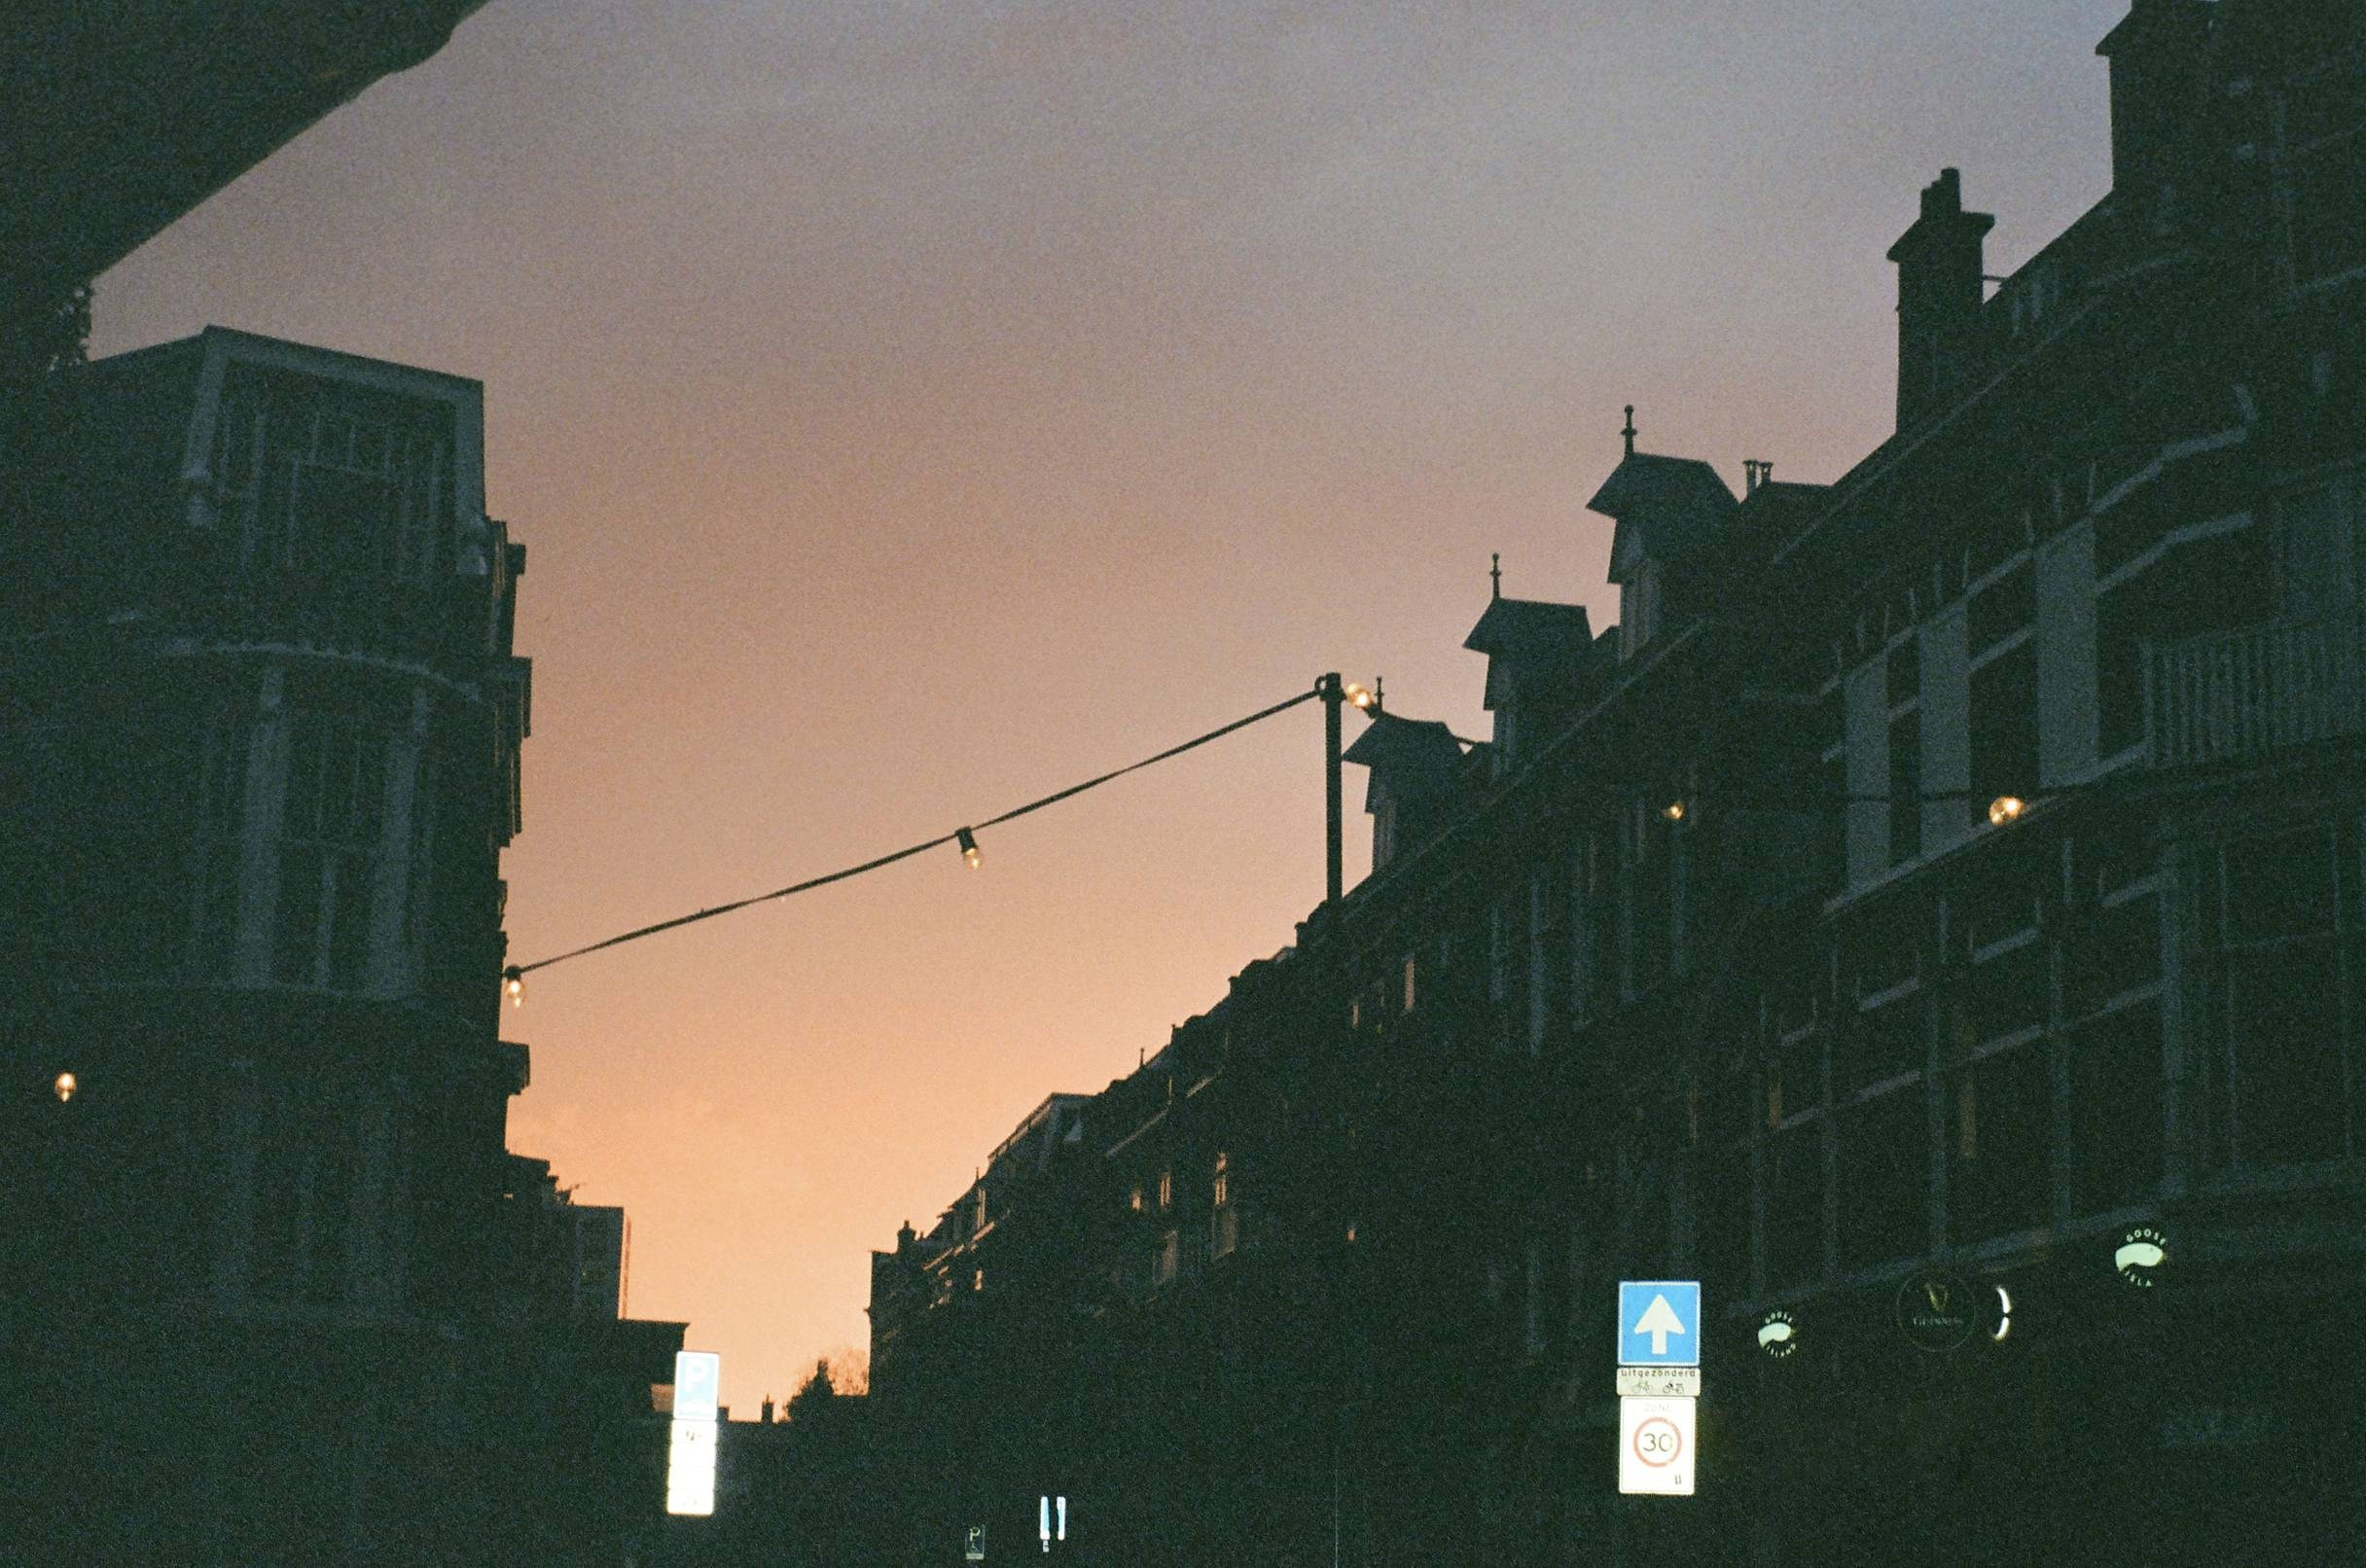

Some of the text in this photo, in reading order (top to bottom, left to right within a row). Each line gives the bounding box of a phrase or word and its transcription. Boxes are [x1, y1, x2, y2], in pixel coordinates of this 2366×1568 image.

[2126, 1229, 2167, 1245] GOOSE
[686, 1358, 708, 1394] P
[1621, 1369, 1696, 1378] uitgezonderd
[1643, 1433, 1673, 1452] 30
